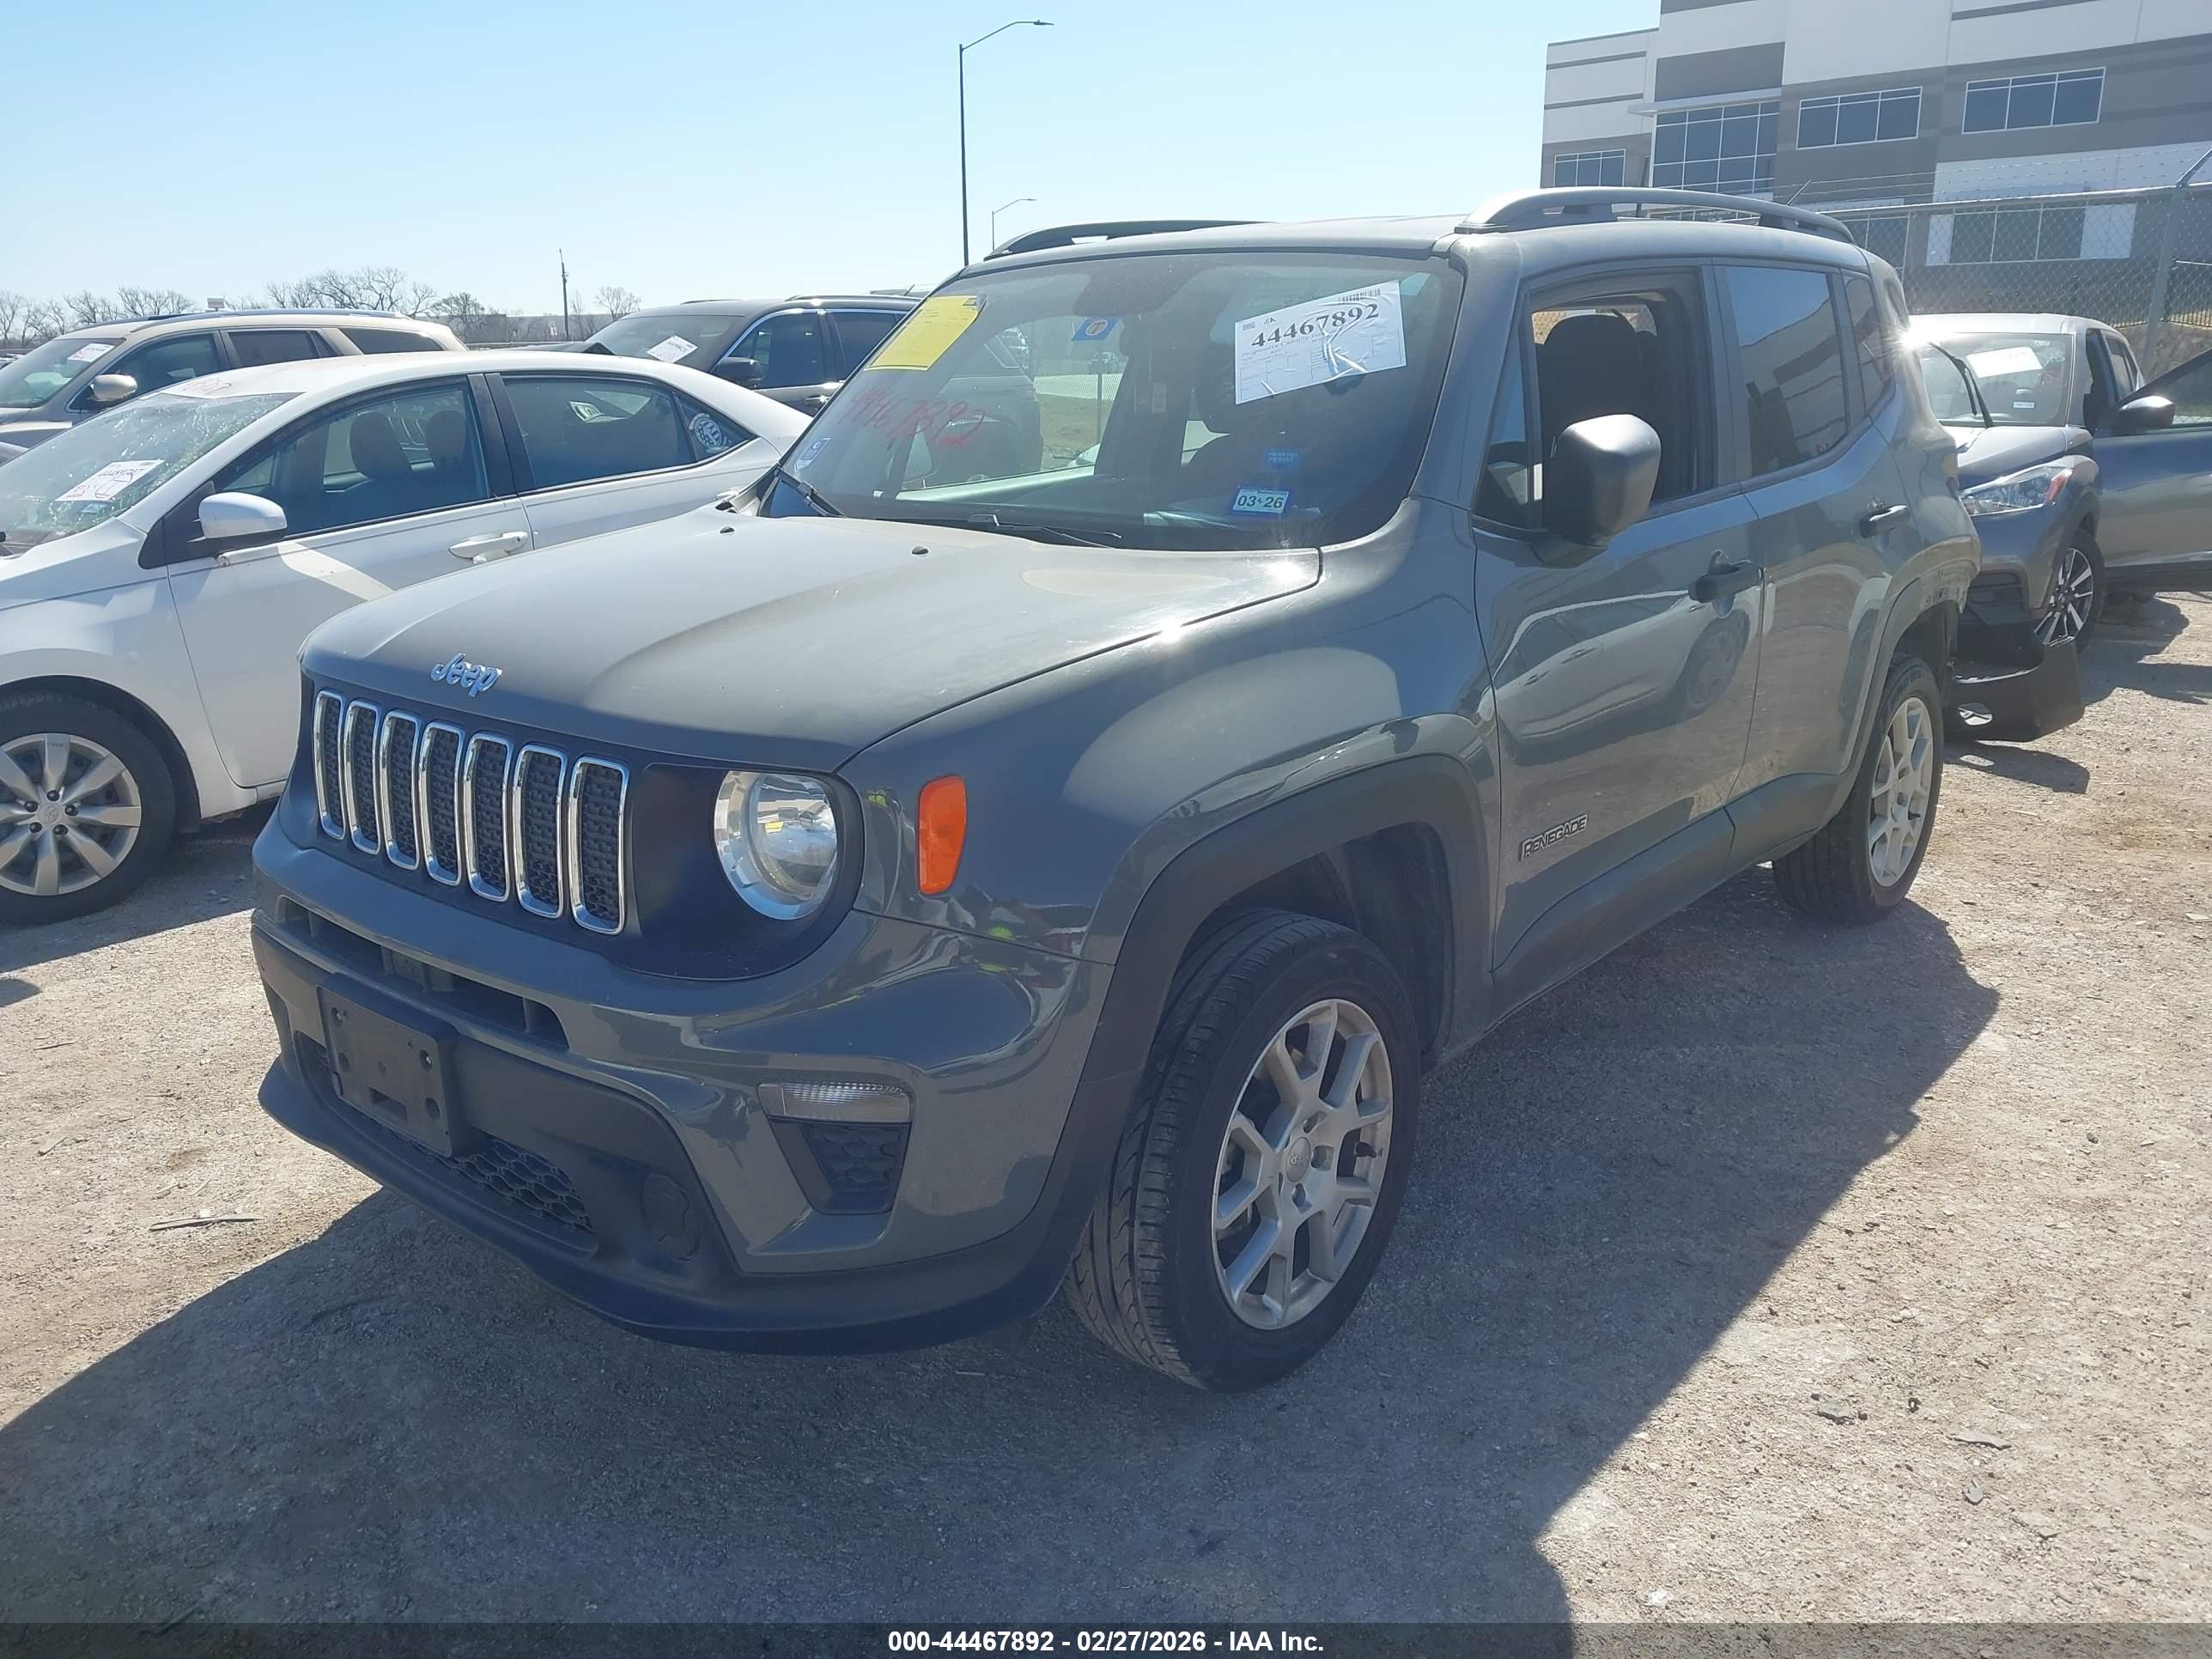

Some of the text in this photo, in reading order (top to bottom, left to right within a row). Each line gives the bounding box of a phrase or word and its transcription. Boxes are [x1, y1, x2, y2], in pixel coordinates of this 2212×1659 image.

[1251, 303, 1380, 347] 44467892
[1237, 495, 1284, 509] 03 26
[431, 653, 502, 697] Jeep
[1519, 813, 1588, 861] RENEGADE
